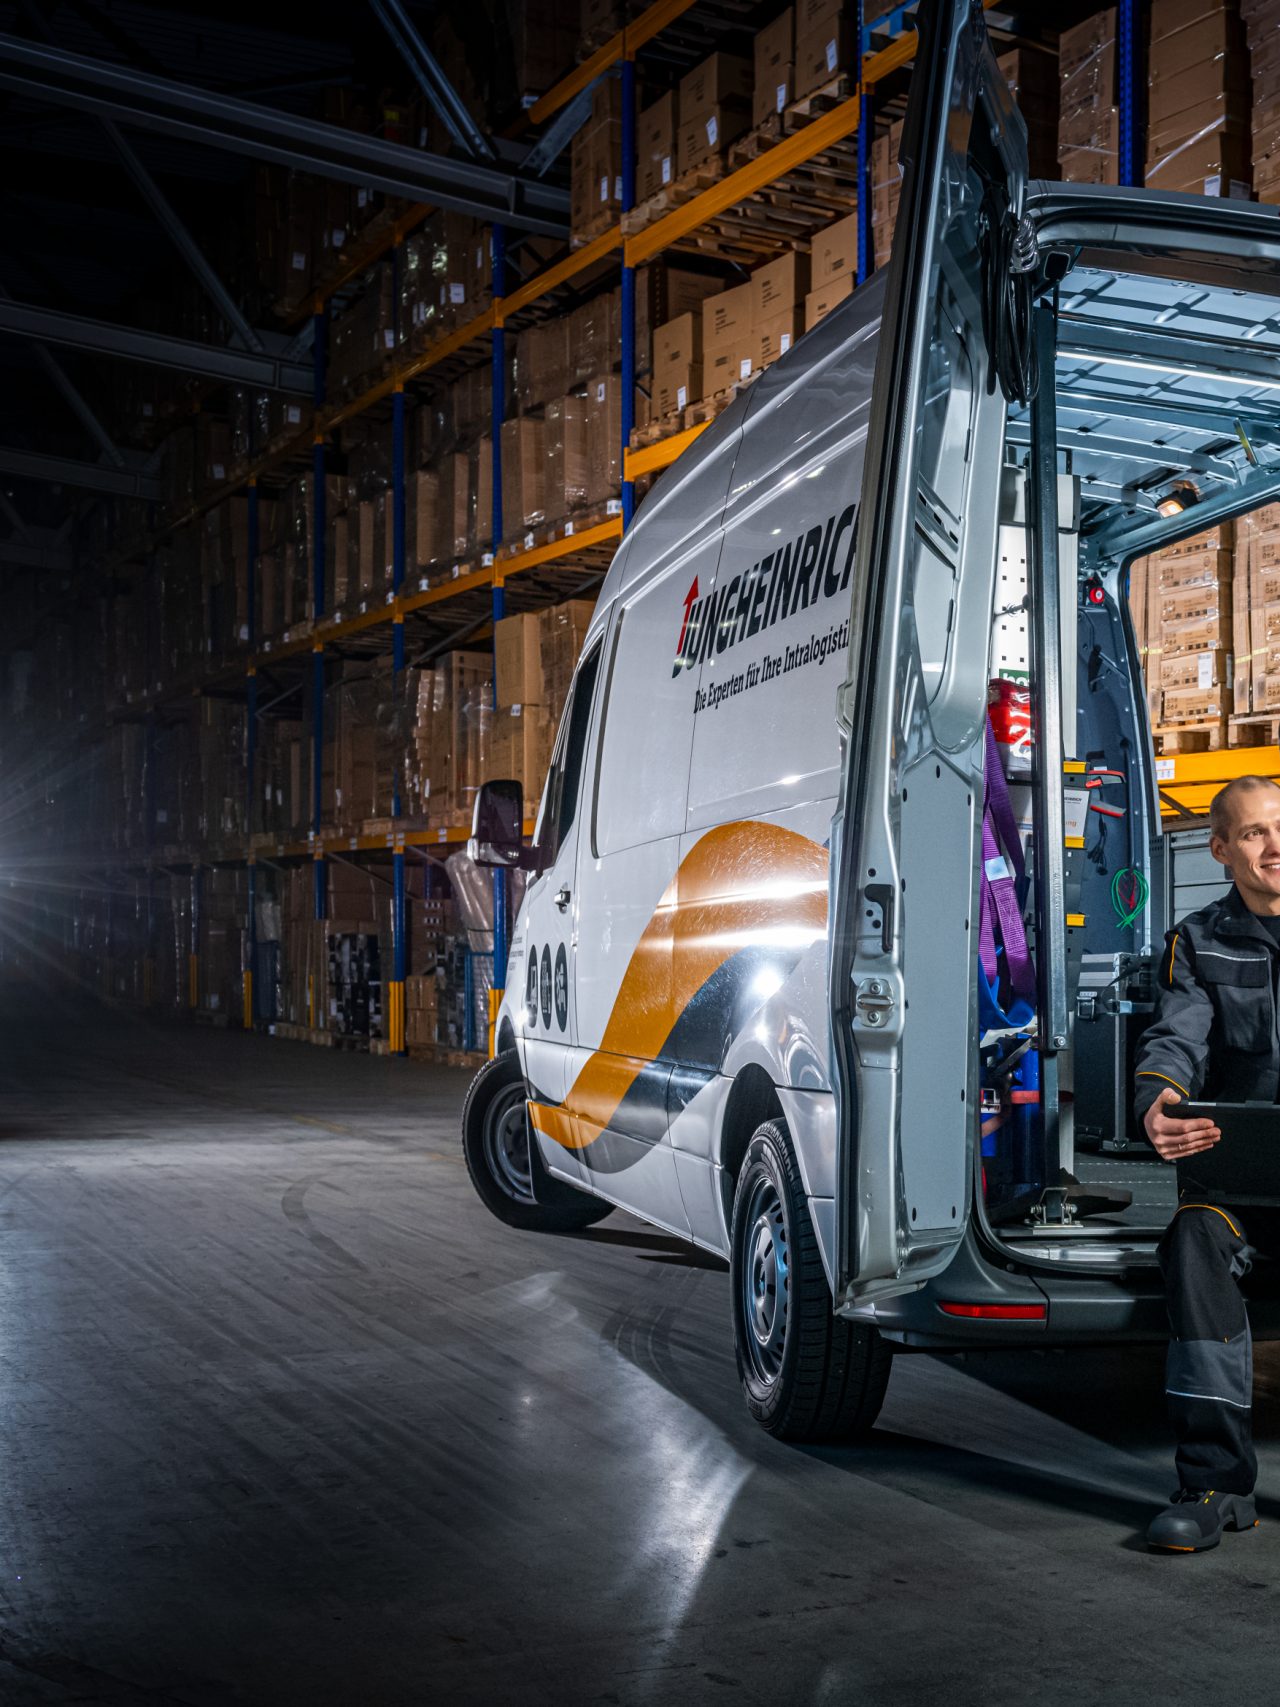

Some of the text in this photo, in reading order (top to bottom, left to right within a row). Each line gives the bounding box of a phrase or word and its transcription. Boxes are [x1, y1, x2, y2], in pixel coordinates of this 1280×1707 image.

[693, 622, 850, 714] Die Experten für Ihre Intralogisti
